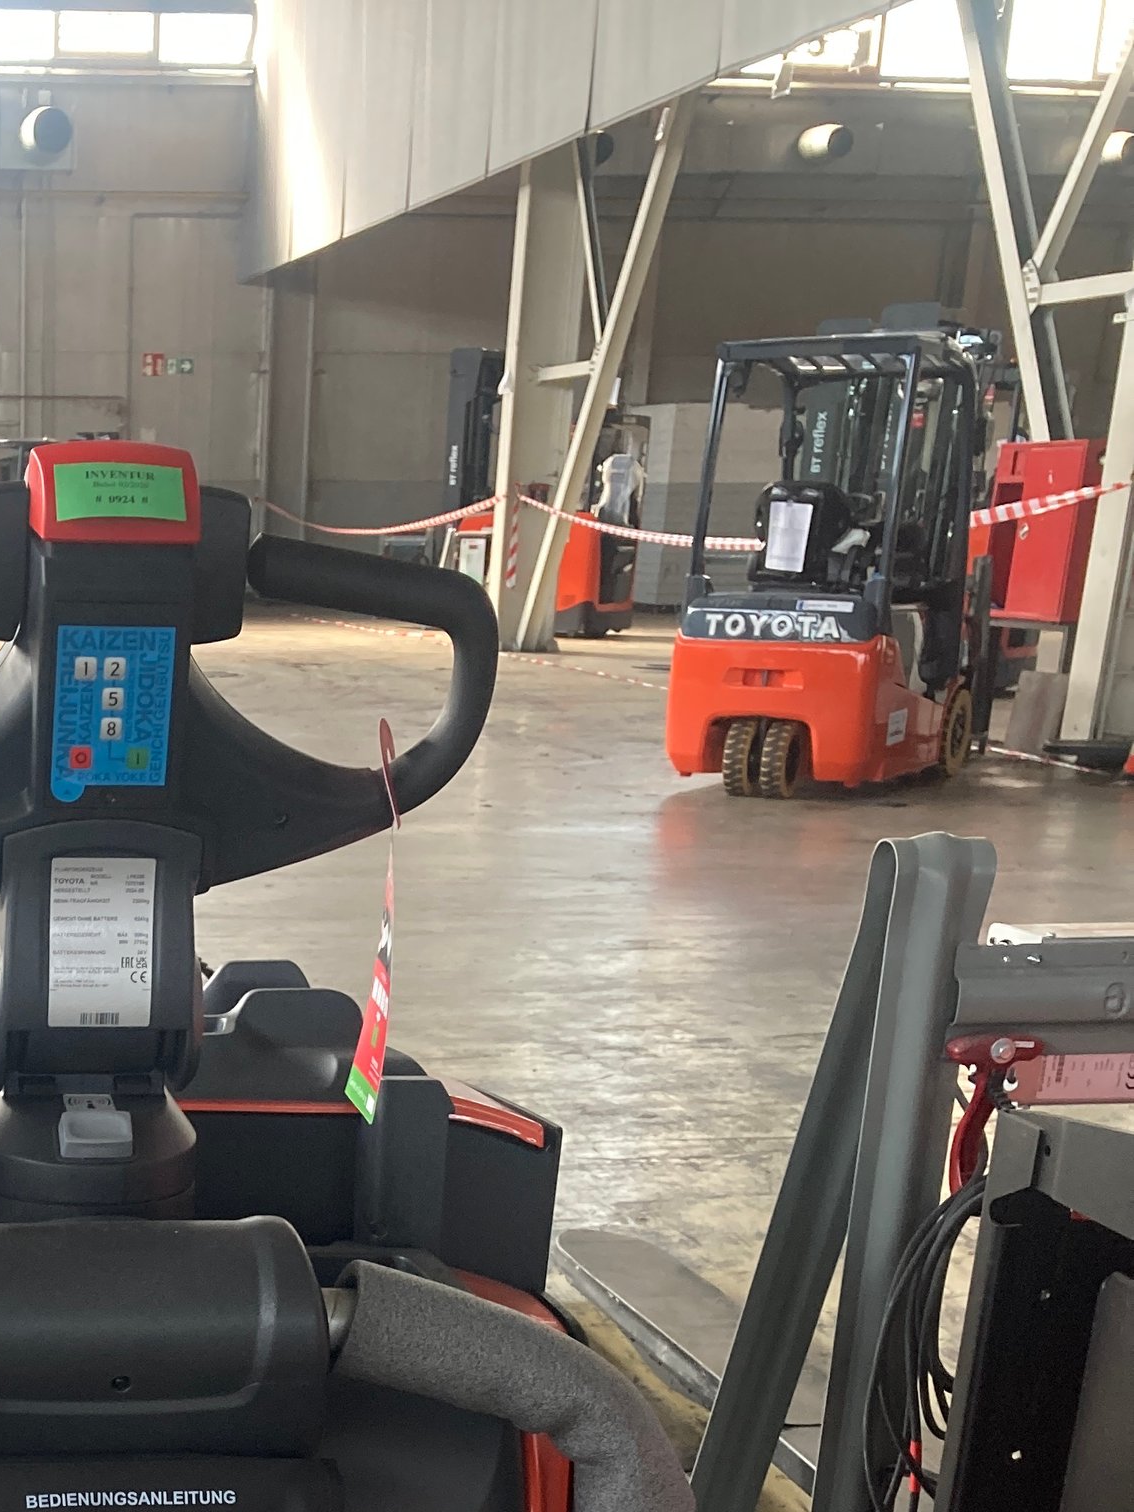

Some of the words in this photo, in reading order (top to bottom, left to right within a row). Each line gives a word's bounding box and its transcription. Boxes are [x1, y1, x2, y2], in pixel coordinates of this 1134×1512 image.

[85, 470, 156, 481] INVENTUR
[705, 613, 841, 639] TOYOTA
[62, 630, 156, 652] KAIZEN
[110, 662, 120, 677] 2
[108, 692, 118, 706] 5
[135, 653, 158, 744] JIDOKA
[106, 722, 117, 736] 8
[25, 1490, 236, 1509] BEDIENUNGSANLEITUNG
